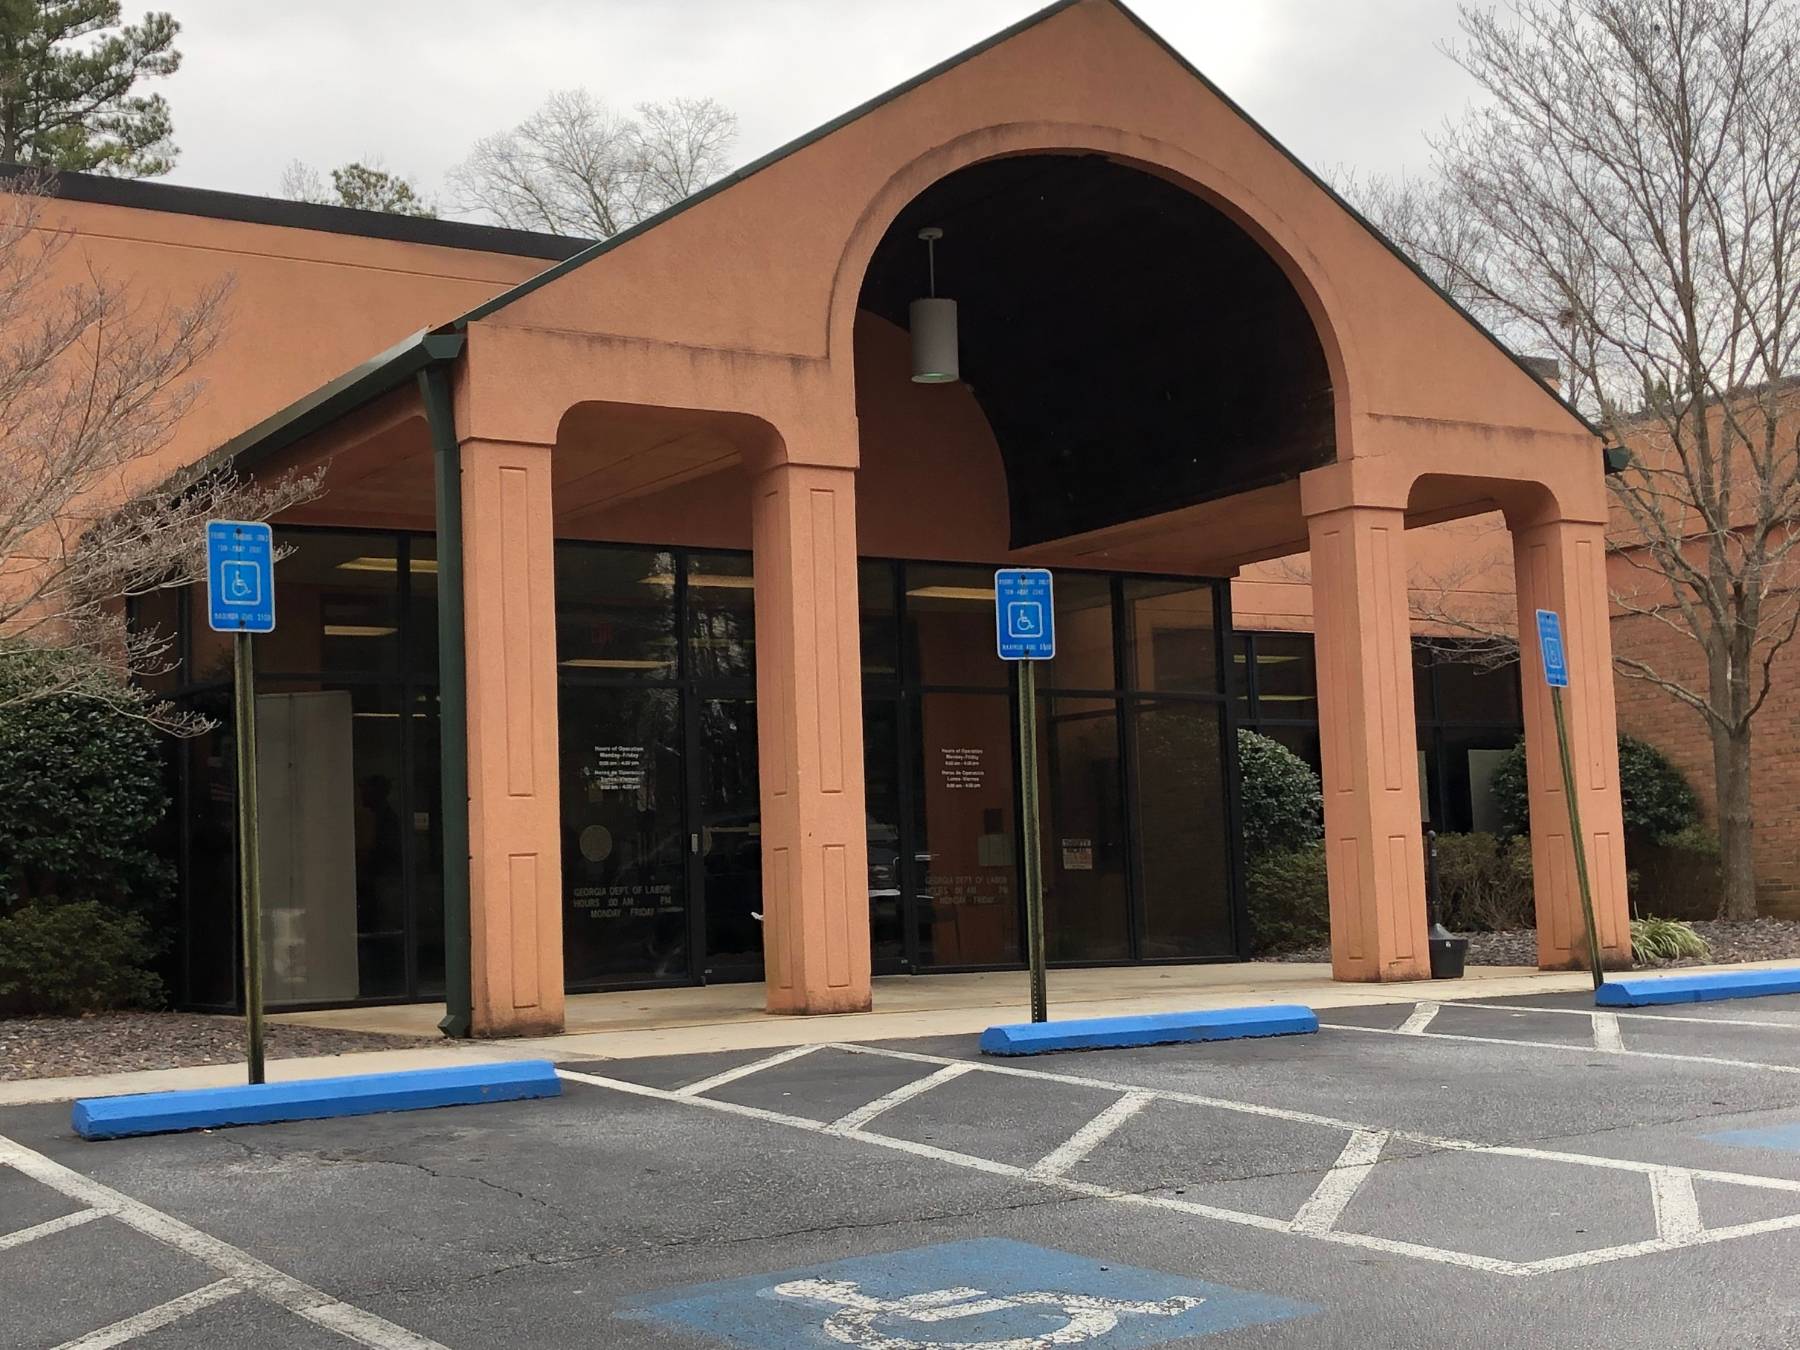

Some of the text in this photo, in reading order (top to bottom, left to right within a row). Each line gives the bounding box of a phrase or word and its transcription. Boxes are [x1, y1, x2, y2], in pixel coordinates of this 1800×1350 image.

[573, 887, 607, 897] GEORGIA
[632, 885, 643, 895] OF
[645, 884, 672, 894] LABOR
[573, 897, 600, 908] HOURS
[622, 896, 634, 906] AM
[660, 895, 672, 905] PM
[590, 907, 655, 918] MONDAY FRIDAY
